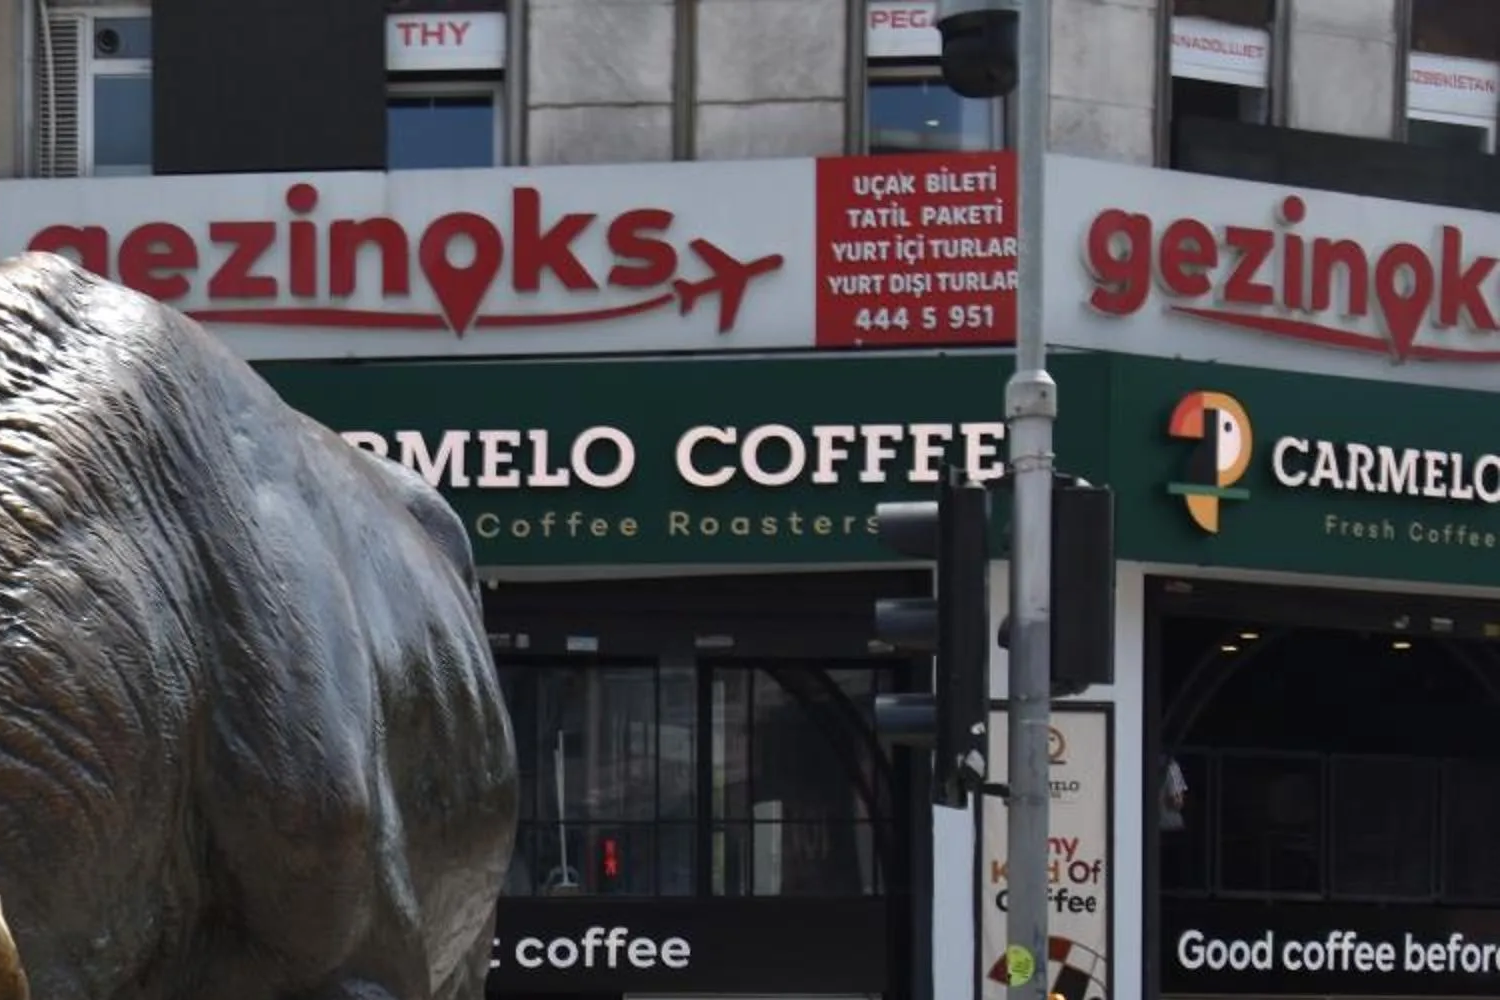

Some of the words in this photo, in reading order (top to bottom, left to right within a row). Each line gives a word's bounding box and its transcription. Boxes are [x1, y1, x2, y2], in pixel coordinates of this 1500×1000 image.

[395, 20, 471, 47] THY
[870, 9, 937, 30] PEG
[853, 174, 916, 200] UÇAK
[925, 165, 997, 193] BİLETİ
[847, 201, 912, 228] TATİL
[921, 198, 1003, 226] PAKETİ
[831, 240, 891, 262] YURT
[895, 234, 925, 265] İÇİ
[929, 237, 1018, 259] TURLAR
[827, 273, 885, 295] YURT
[889, 272, 933, 298] DIŞI
[1086, 194, 1500, 364] gezinok
[855, 306, 910, 330] 444
[922, 306, 937, 329] 5
[949, 305, 994, 329] 951
[675, 423, 1005, 487] COFFEE
[1272, 435, 1500, 504] CARMELO
[475, 511, 638, 538] Coffee
[668, 511, 880, 536] Roasters
[1325, 514, 1395, 541] Fresh
[1408, 521, 1496, 548] Coffee
[1068, 859, 1101, 885] Of
[515, 926, 691, 969] coffee
[1178, 929, 1273, 970] Good
[1282, 930, 1396, 972] coffee
[1403, 932, 1500, 973] befor
